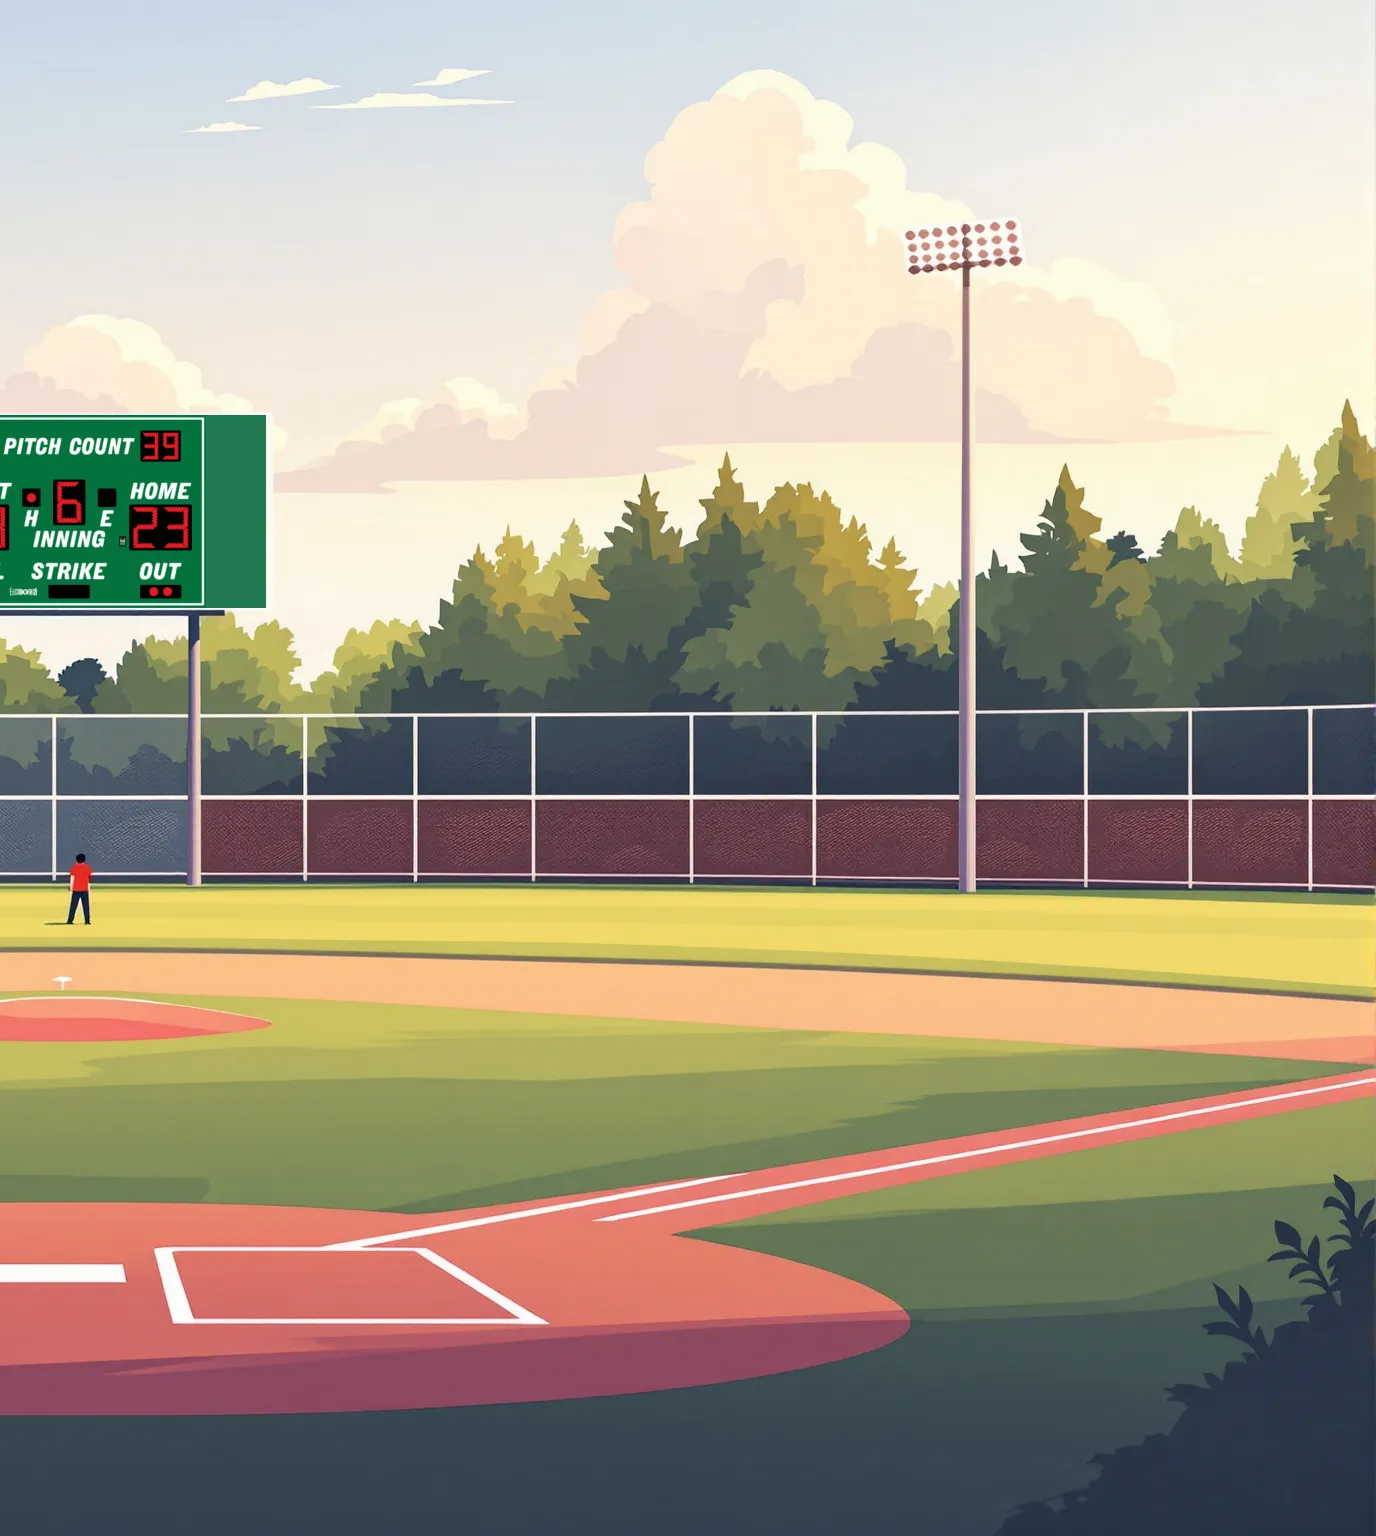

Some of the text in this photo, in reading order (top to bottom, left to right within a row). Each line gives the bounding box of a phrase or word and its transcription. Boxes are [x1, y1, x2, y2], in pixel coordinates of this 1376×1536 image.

[4, 437, 135, 455] PITCH COUNT
[143, 433, 178, 460] 39
[130, 482, 192, 500] HOME
[57, 481, 82, 523] 6
[24, 509, 39, 527] H
[100, 509, 114, 527] E
[133, 507, 189, 548] 23
[33, 530, 106, 548] INNING
[31, 562, 107, 580] STRIKE
[139, 562, 182, 580] OUT
